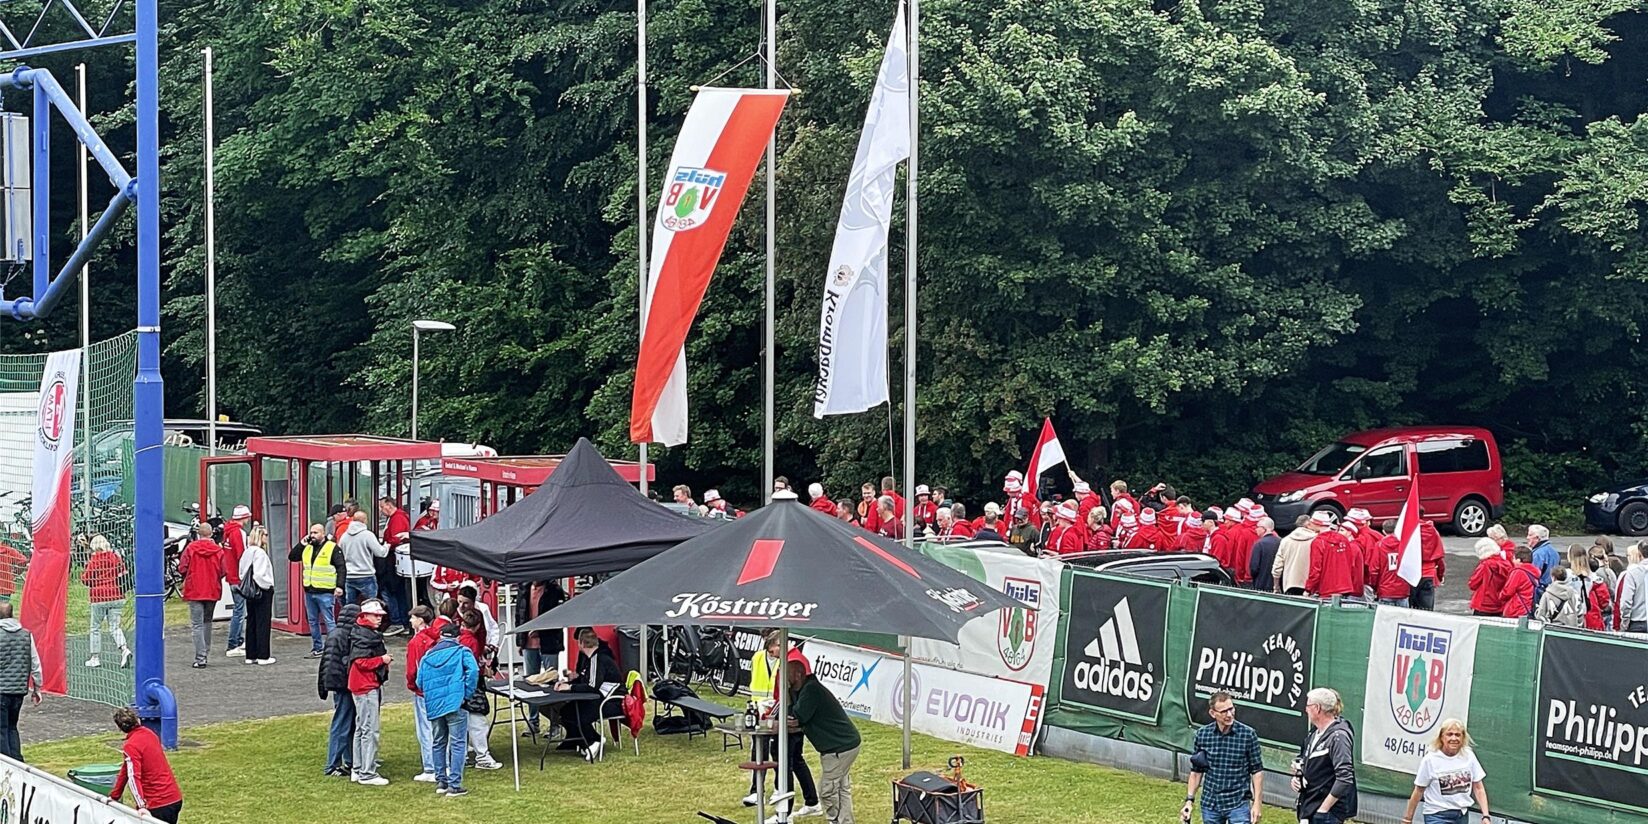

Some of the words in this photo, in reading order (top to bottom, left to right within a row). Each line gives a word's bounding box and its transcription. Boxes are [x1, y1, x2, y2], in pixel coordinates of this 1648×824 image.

[665, 593, 818, 620] Köstritzer
[1399, 628, 1447, 655] hüls
[815, 655, 857, 682] tipstar
[1074, 657, 1153, 701] adidas
[1195, 647, 1284, 703] Philipp
[1262, 633, 1304, 707] TEAMSPORT
[926, 688, 1010, 731] EVONIK
[1627, 685, 1648, 709] TE
[957, 726, 1004, 745] INDUSTRIES
[1384, 736, 1415, 755] 48/64
[1545, 740, 1613, 759] teamsport-philipp.de
